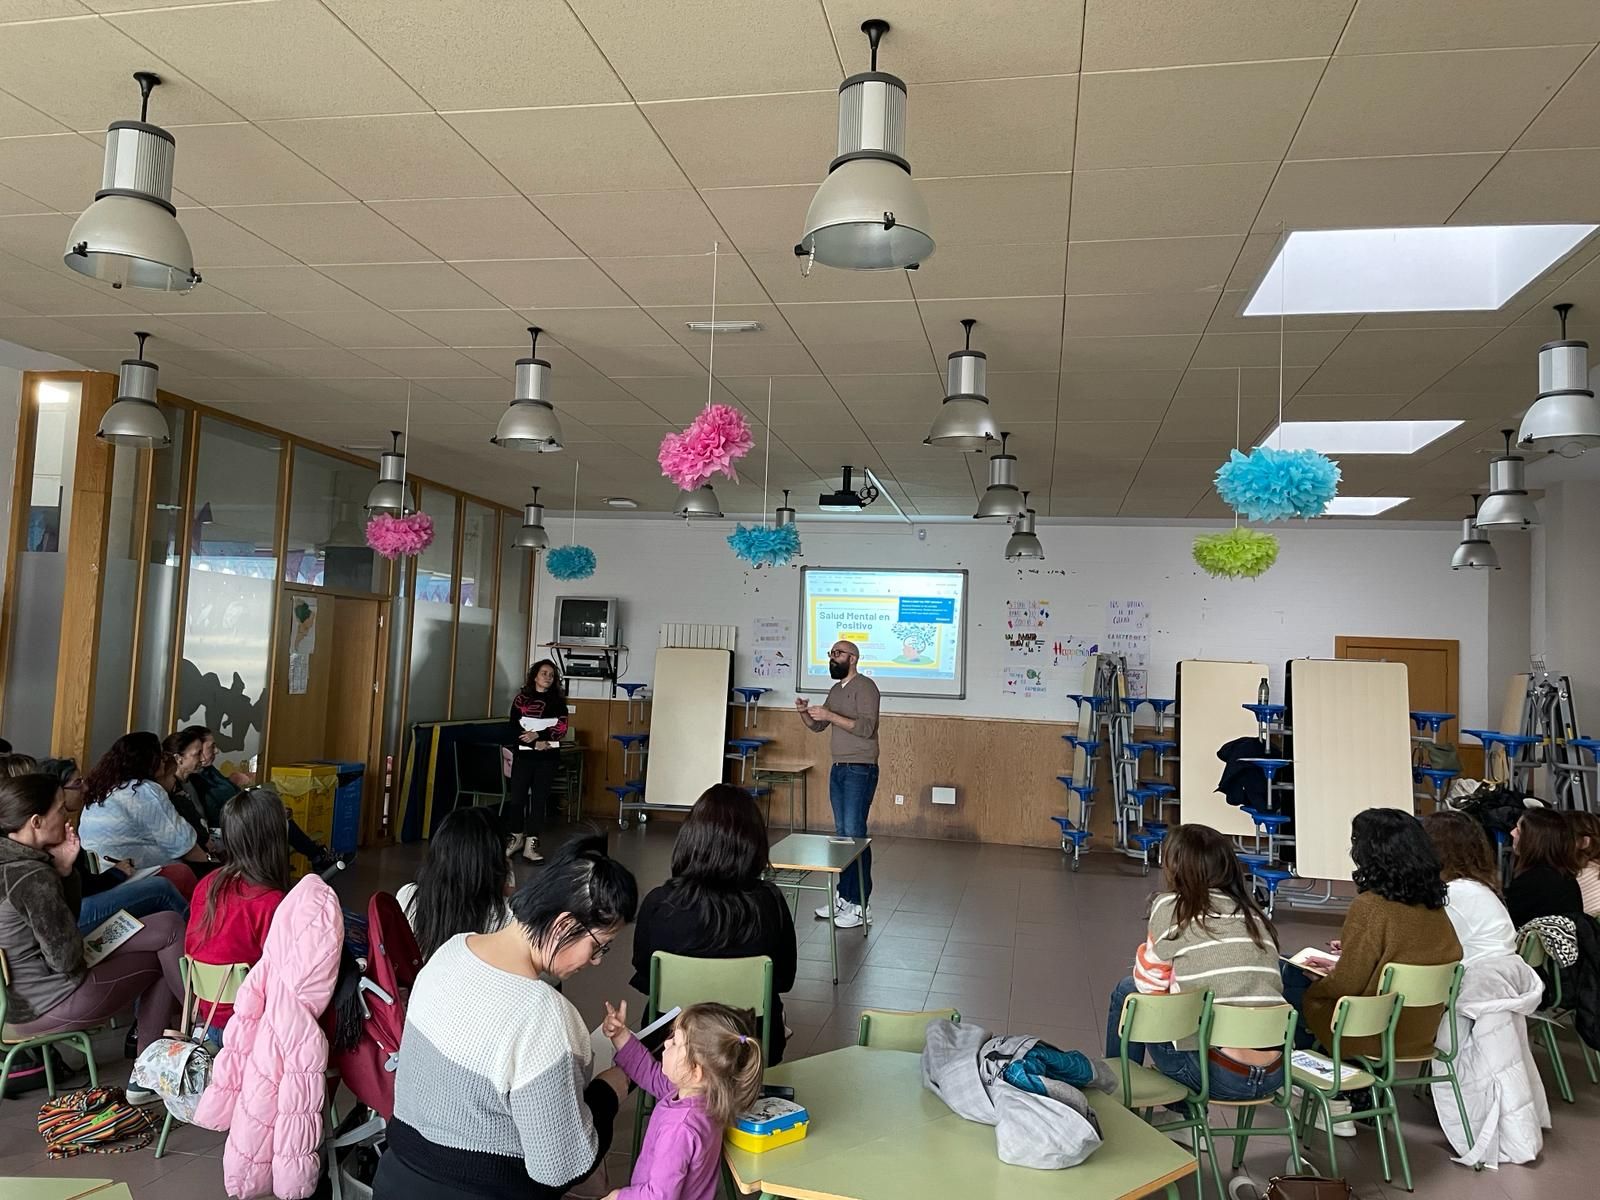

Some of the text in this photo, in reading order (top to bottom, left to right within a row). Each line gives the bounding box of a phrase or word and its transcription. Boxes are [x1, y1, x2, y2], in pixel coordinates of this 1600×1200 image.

[819, 611, 845, 620] Salud
[846, 612, 877, 621] Mental
[836, 621, 873, 630] Positivo
